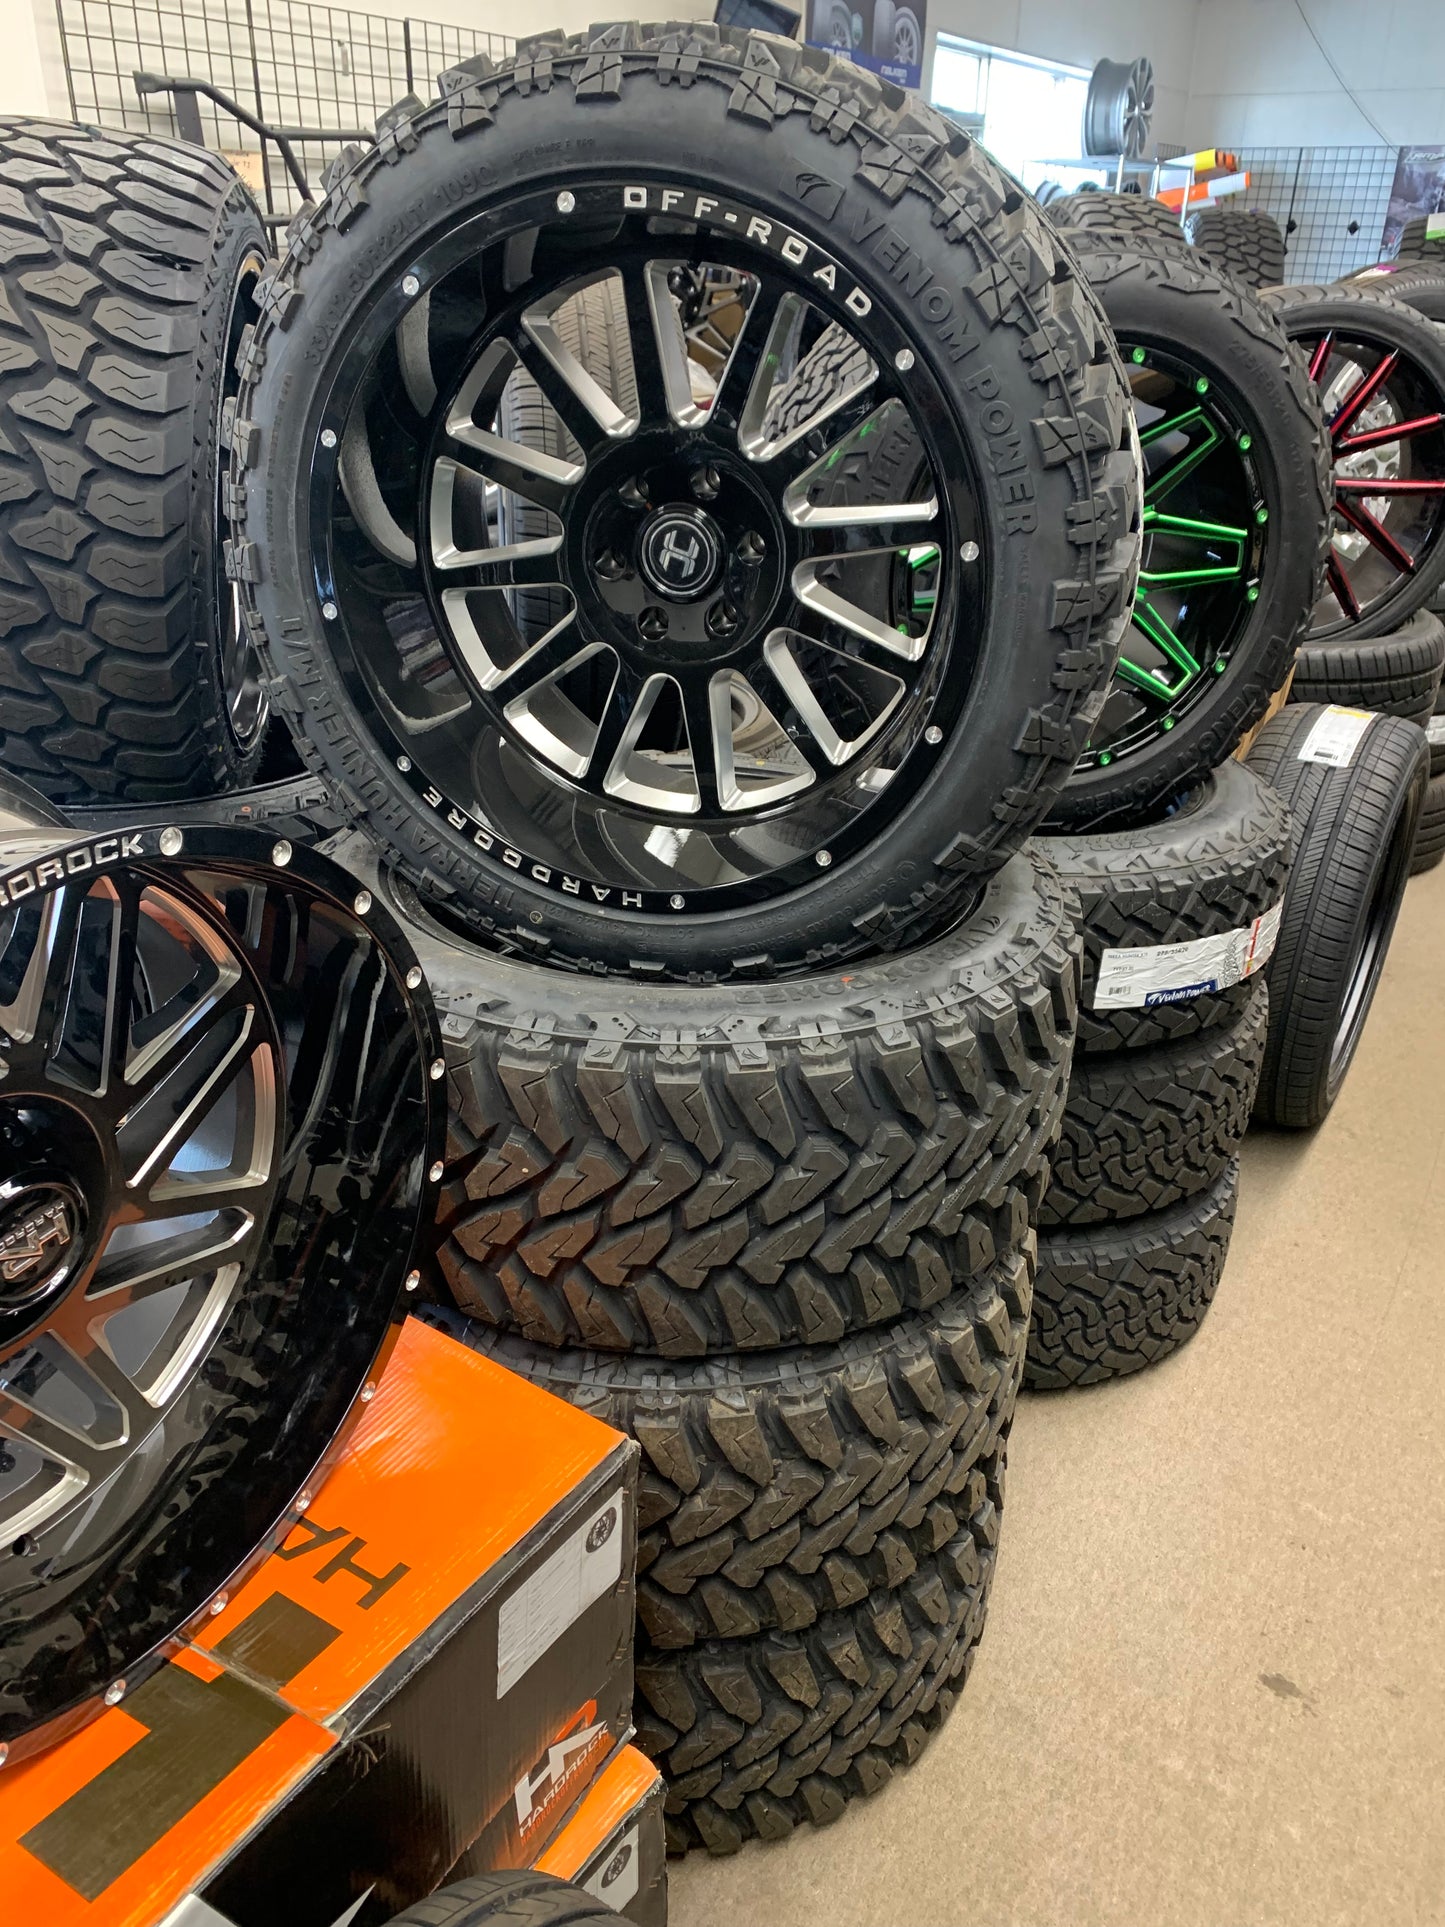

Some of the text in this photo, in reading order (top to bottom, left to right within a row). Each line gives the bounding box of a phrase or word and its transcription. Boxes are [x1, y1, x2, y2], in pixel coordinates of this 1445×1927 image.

[623, 186, 872, 317] OFF-ROAD
[849, 207, 1039, 537] VENOM POWER
[275, 615, 514, 914] TERRA HUNTER M/T
[0, 833, 144, 906] DROCK
[422, 786, 642, 908] HARDCORE
[273, 1515, 412, 1611] HA
[519, 1722, 609, 1838] HARDROCK
